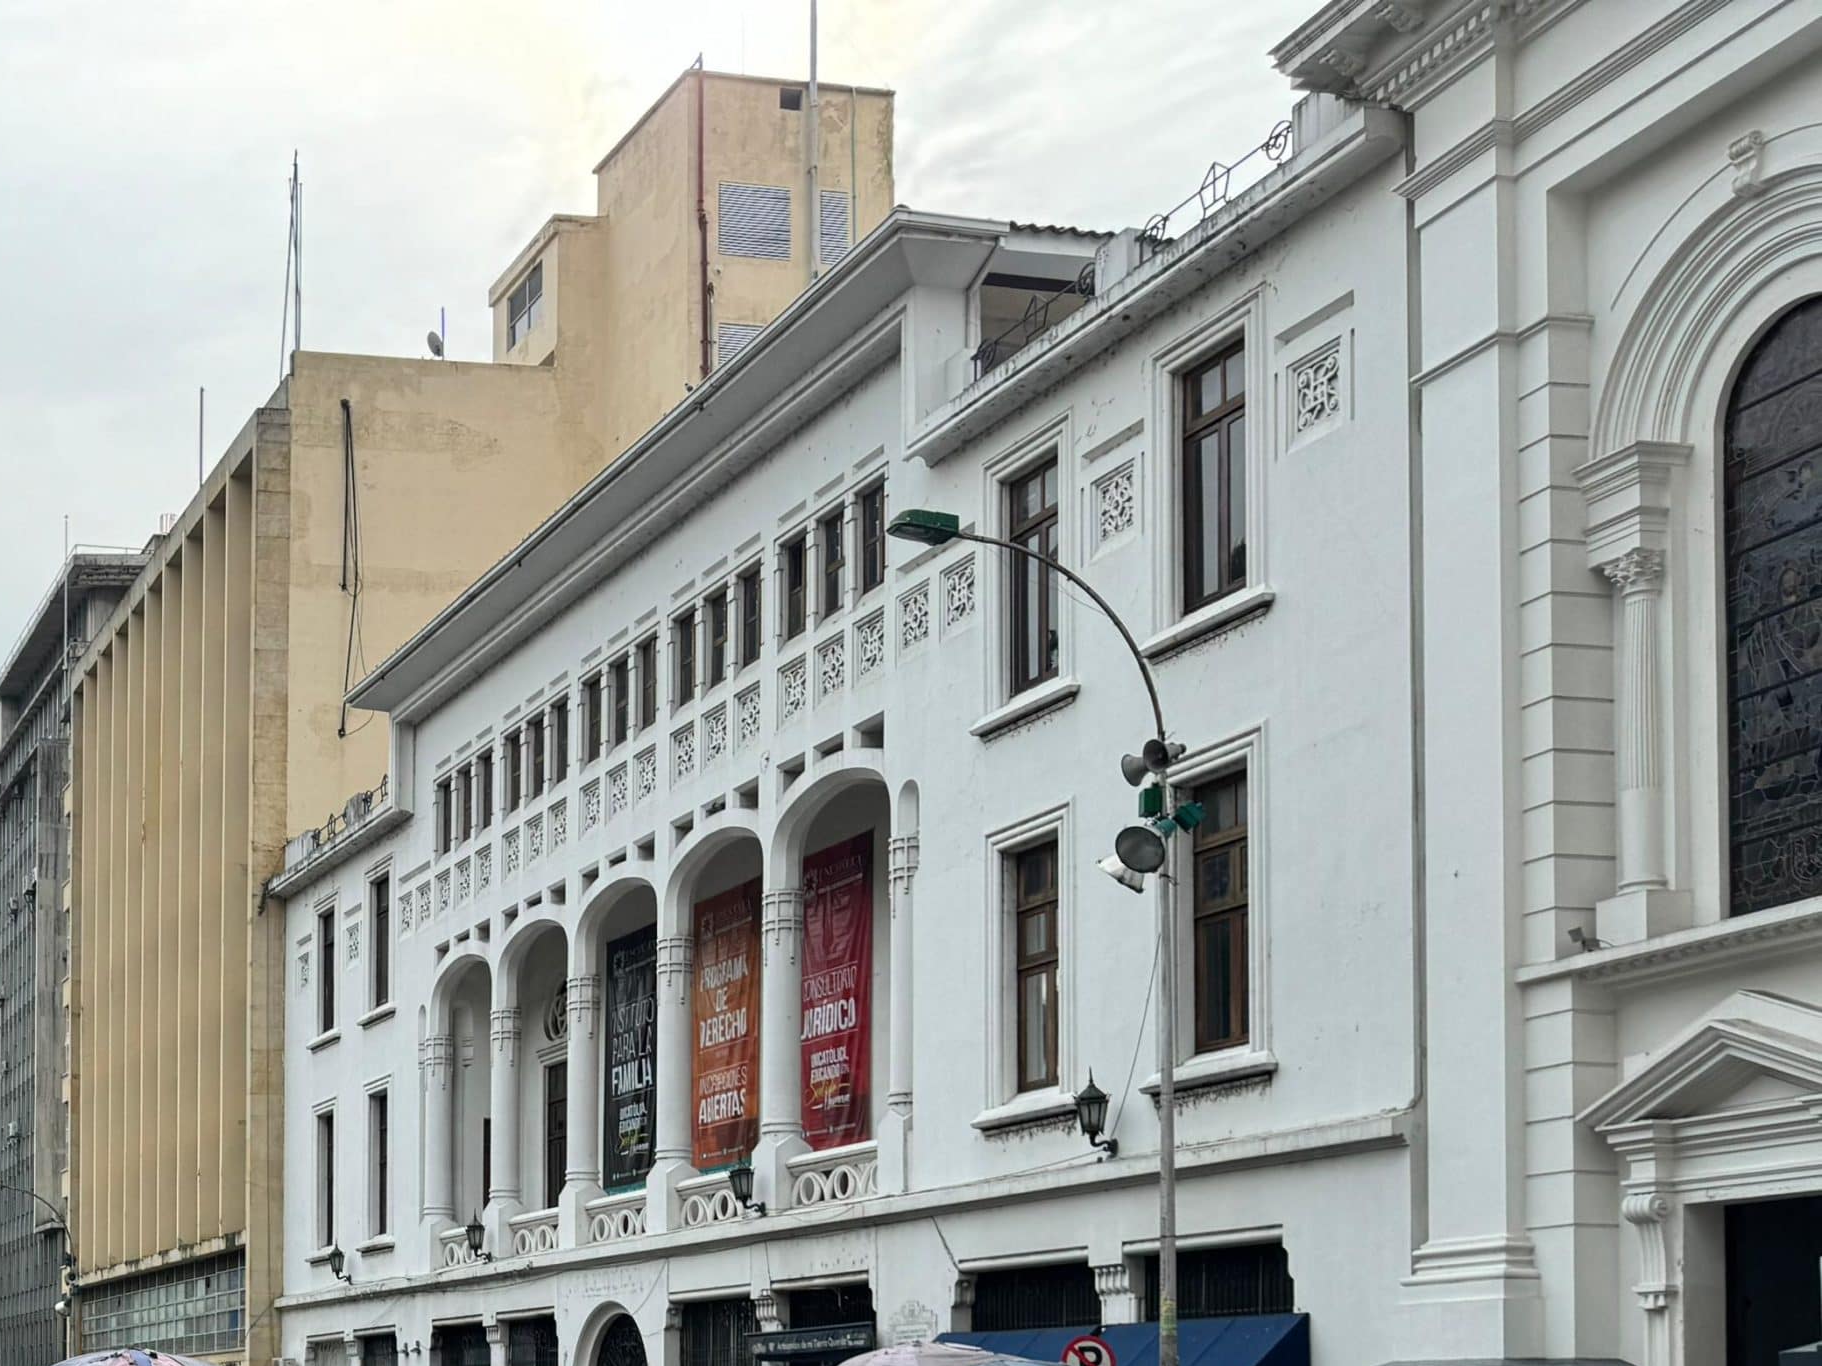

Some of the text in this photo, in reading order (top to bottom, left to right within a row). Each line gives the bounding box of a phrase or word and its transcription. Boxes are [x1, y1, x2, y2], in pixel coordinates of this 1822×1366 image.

[716, 987, 728, 1012] DE
[800, 997, 856, 1040] JURÍDICO
[699, 1007, 747, 1049] DERECHO
